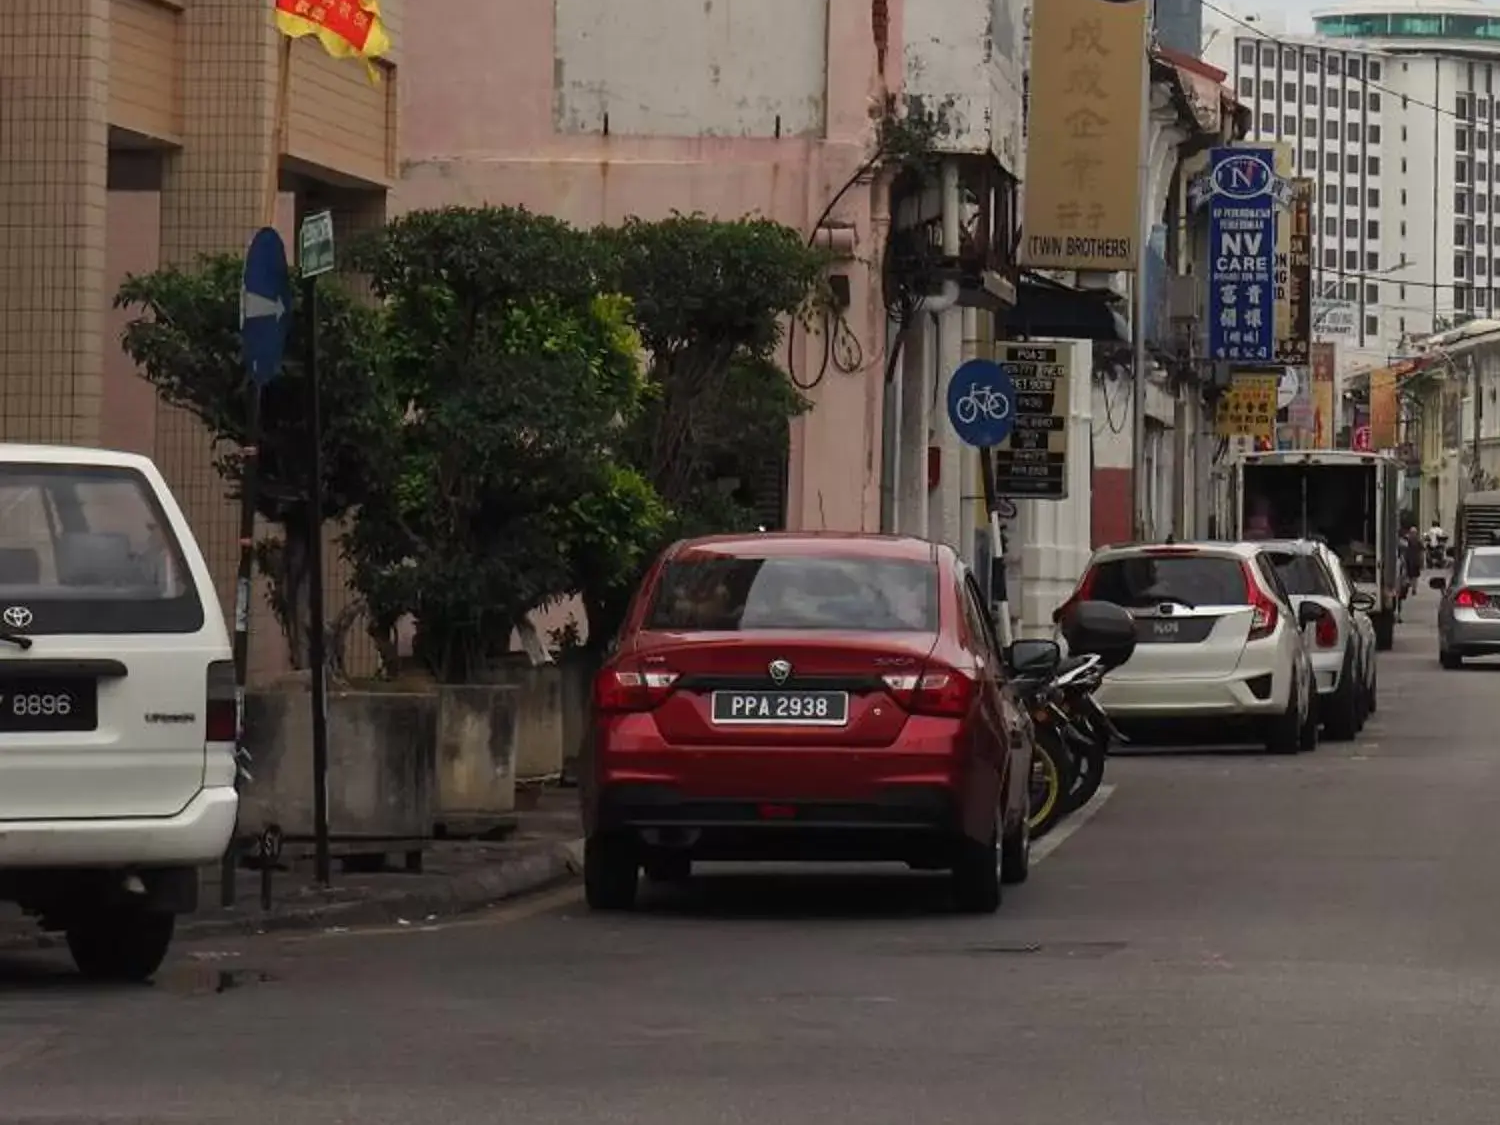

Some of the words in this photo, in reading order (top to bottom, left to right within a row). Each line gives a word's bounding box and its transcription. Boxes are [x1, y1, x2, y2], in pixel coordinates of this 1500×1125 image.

[1221, 232, 1262, 256] NV
[1216, 257, 1268, 272] CARE
[13, 694, 72, 716] 8896
[732, 697, 770, 716] PPA
[777, 697, 828, 716] 2938
